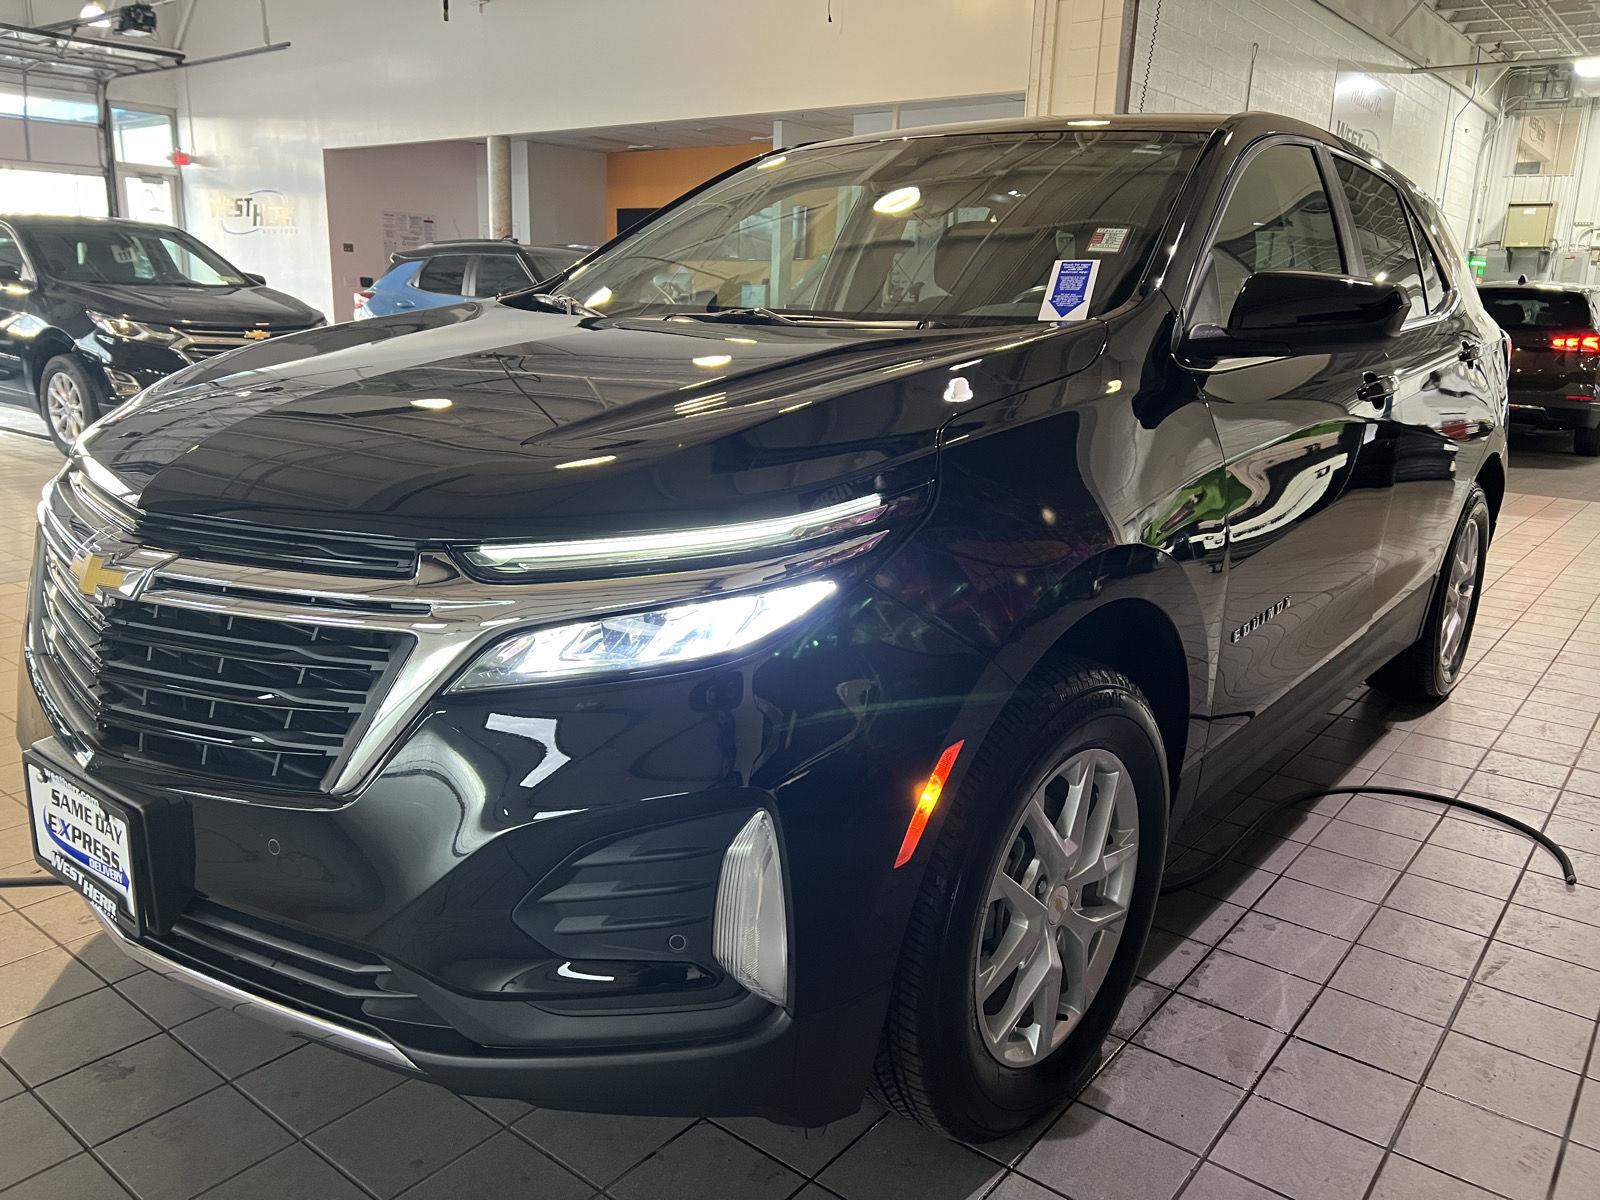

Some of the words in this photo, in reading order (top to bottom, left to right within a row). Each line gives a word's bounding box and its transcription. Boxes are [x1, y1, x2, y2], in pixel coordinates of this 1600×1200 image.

[1230, 595, 1292, 644] EQUINOX
[47, 812, 121, 869] EXPRESS
[51, 788, 92, 826] SAME
[96, 811, 123, 845] DAY
[50, 851, 84, 885] WEST
[82, 878, 118, 917] HERR
[88, 856, 123, 884] DELIVERY
